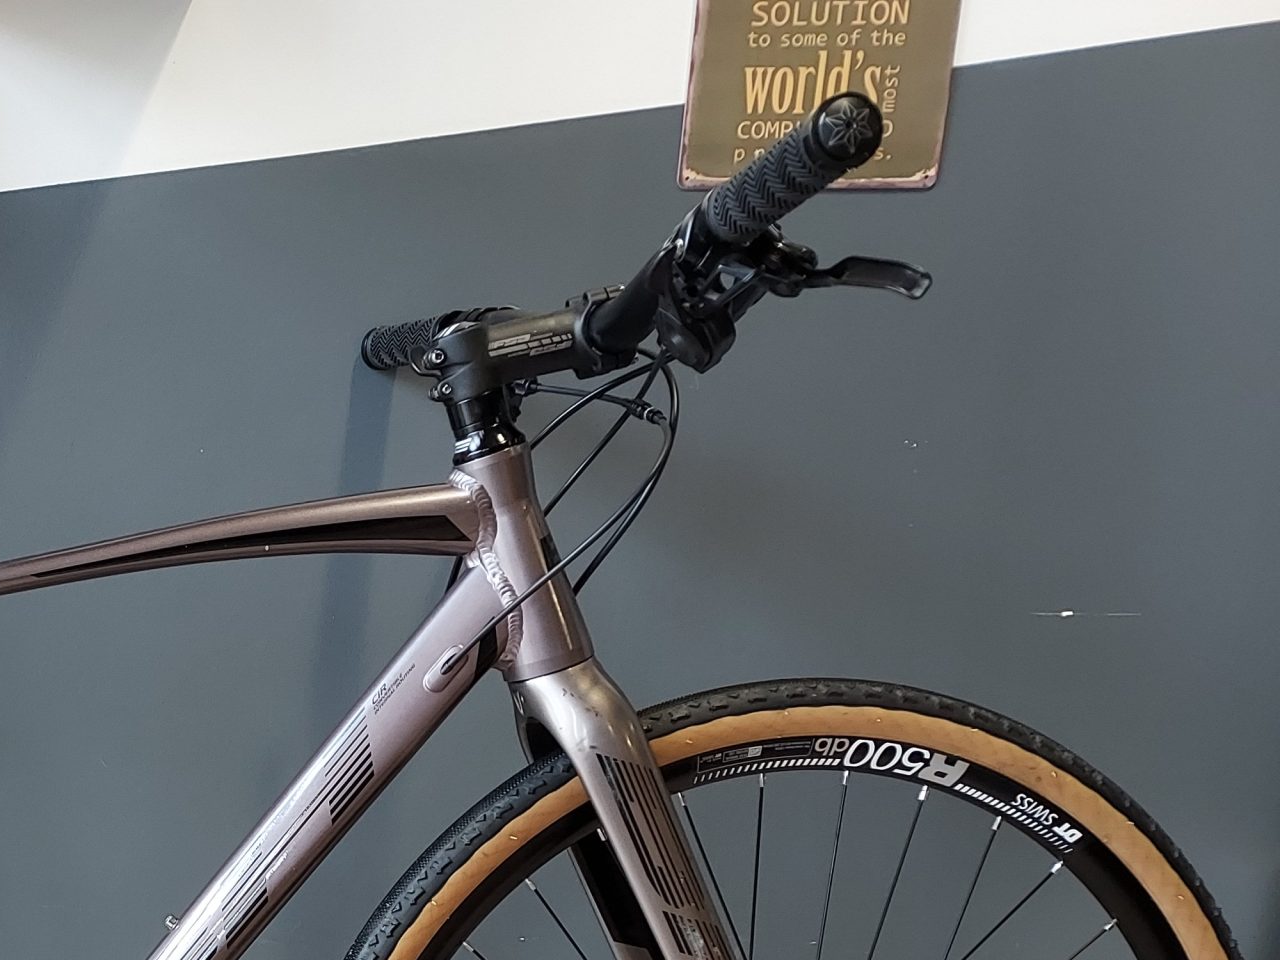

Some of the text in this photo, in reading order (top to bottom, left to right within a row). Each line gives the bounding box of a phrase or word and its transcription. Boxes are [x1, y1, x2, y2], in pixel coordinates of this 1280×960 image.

[748, 28, 906, 47] to some of the
[751, 0, 911, 27] SOLUTION
[744, 50, 882, 115] world's
[881, 65, 901, 113] most
[1010, 793, 1083, 844] DT SWISS
